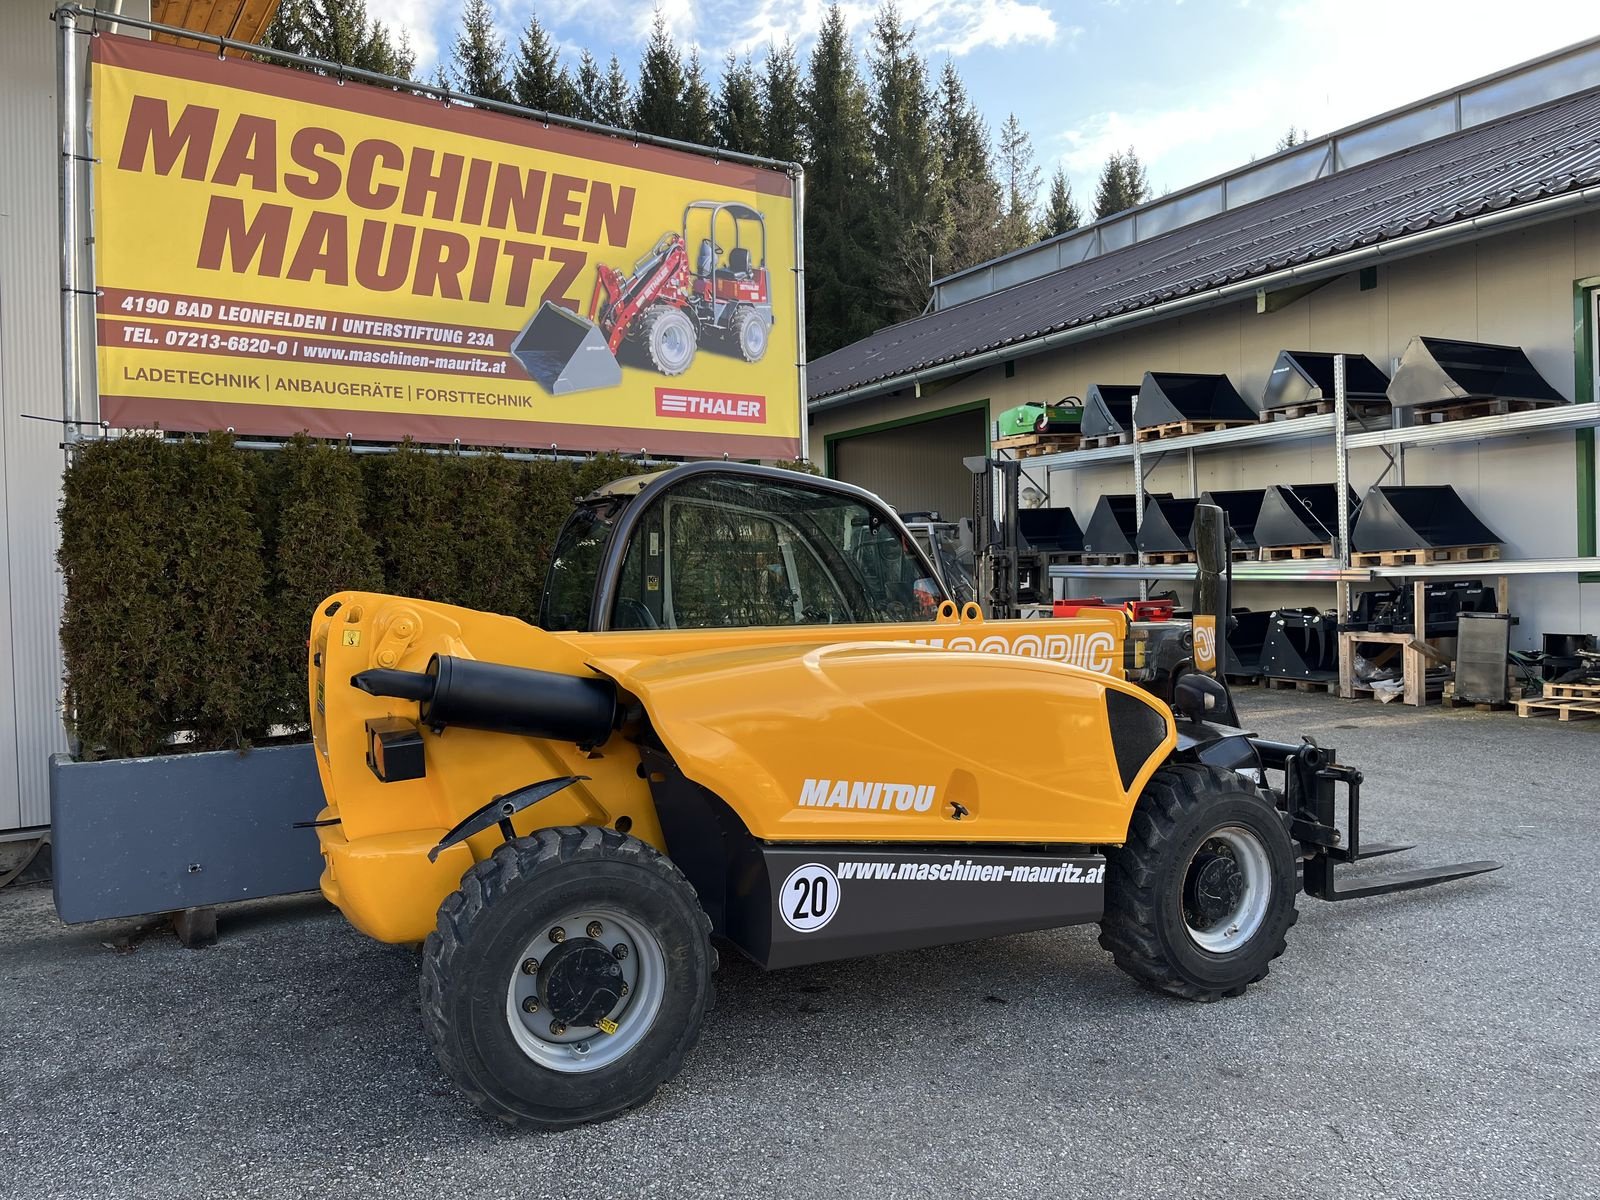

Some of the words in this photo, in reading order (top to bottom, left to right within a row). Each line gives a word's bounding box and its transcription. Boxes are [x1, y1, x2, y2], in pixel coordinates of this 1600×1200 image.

[117, 94, 636, 248] MASCHINEN
[197, 194, 588, 313] MAURITZ
[121, 296, 170, 315] 4190
[174, 301, 213, 319] BAD
[218, 305, 327, 330] LEONFELDEN
[342, 318, 463, 344] UNTERSTIFTUNG
[467, 331, 495, 347] 23A
[123, 326, 159, 345] TEL.
[165, 330, 288, 355] 07213-6820-0
[303, 345, 507, 374] www.maschinen-mauritz.at
[123, 366, 262, 390] LADETECHNIK
[275, 377, 404, 399] ANBAUGERÄTE
[416, 387, 533, 408] FORSTTECHNIK
[687, 396, 761, 417] THALER
[798, 778, 936, 812] MANITOU
[837, 859, 1106, 884] www.maschinen-mauritz.at
[793, 876, 828, 920] 20
